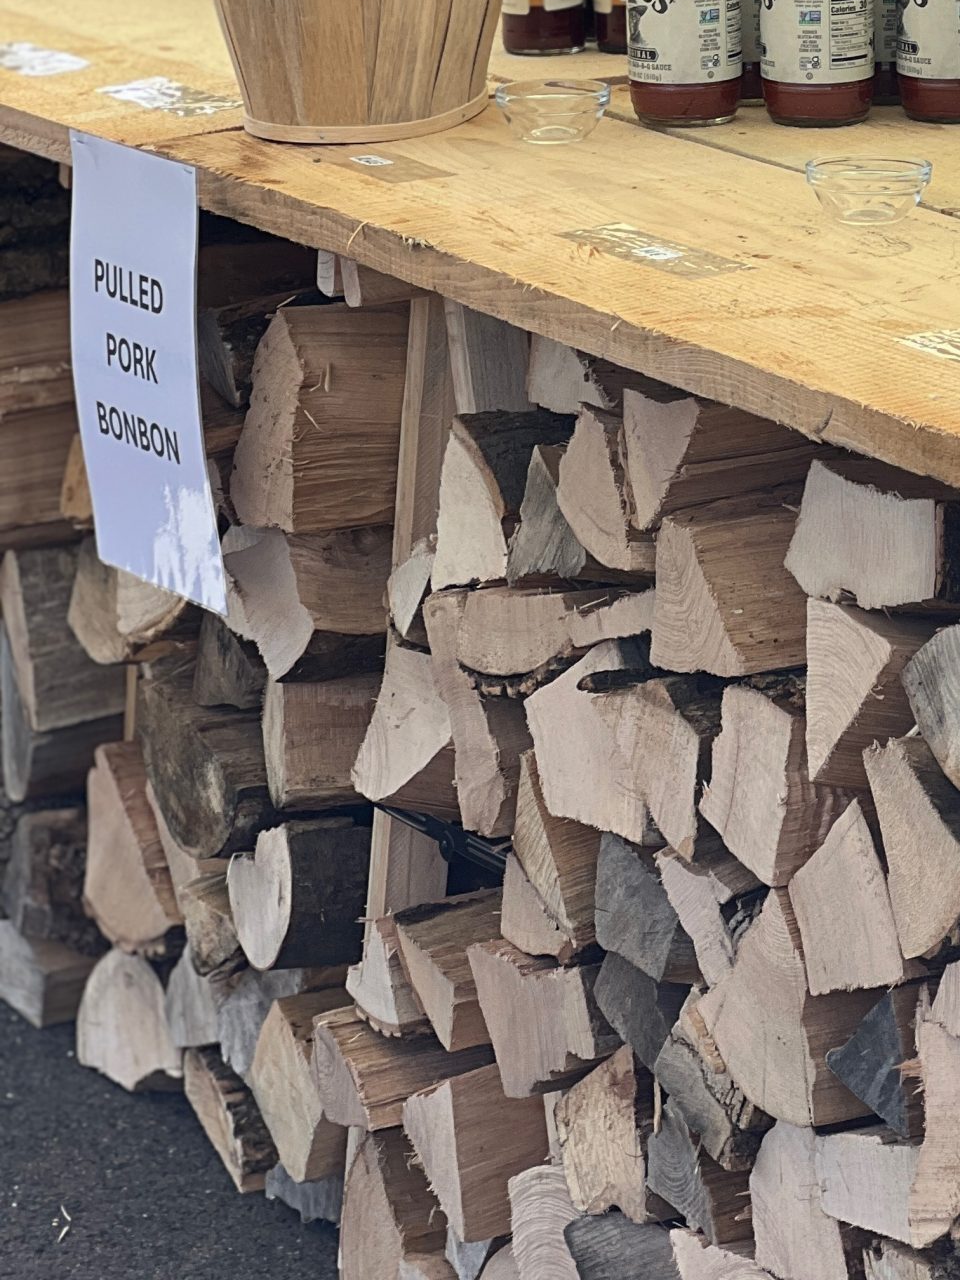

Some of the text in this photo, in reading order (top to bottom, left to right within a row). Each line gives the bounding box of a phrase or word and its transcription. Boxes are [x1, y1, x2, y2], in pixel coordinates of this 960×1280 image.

[830, 5, 856, 14] Calories
[94, 258, 163, 314] PULLED
[106, 332, 158, 384] PORK
[96, 401, 180, 465] BONBON
